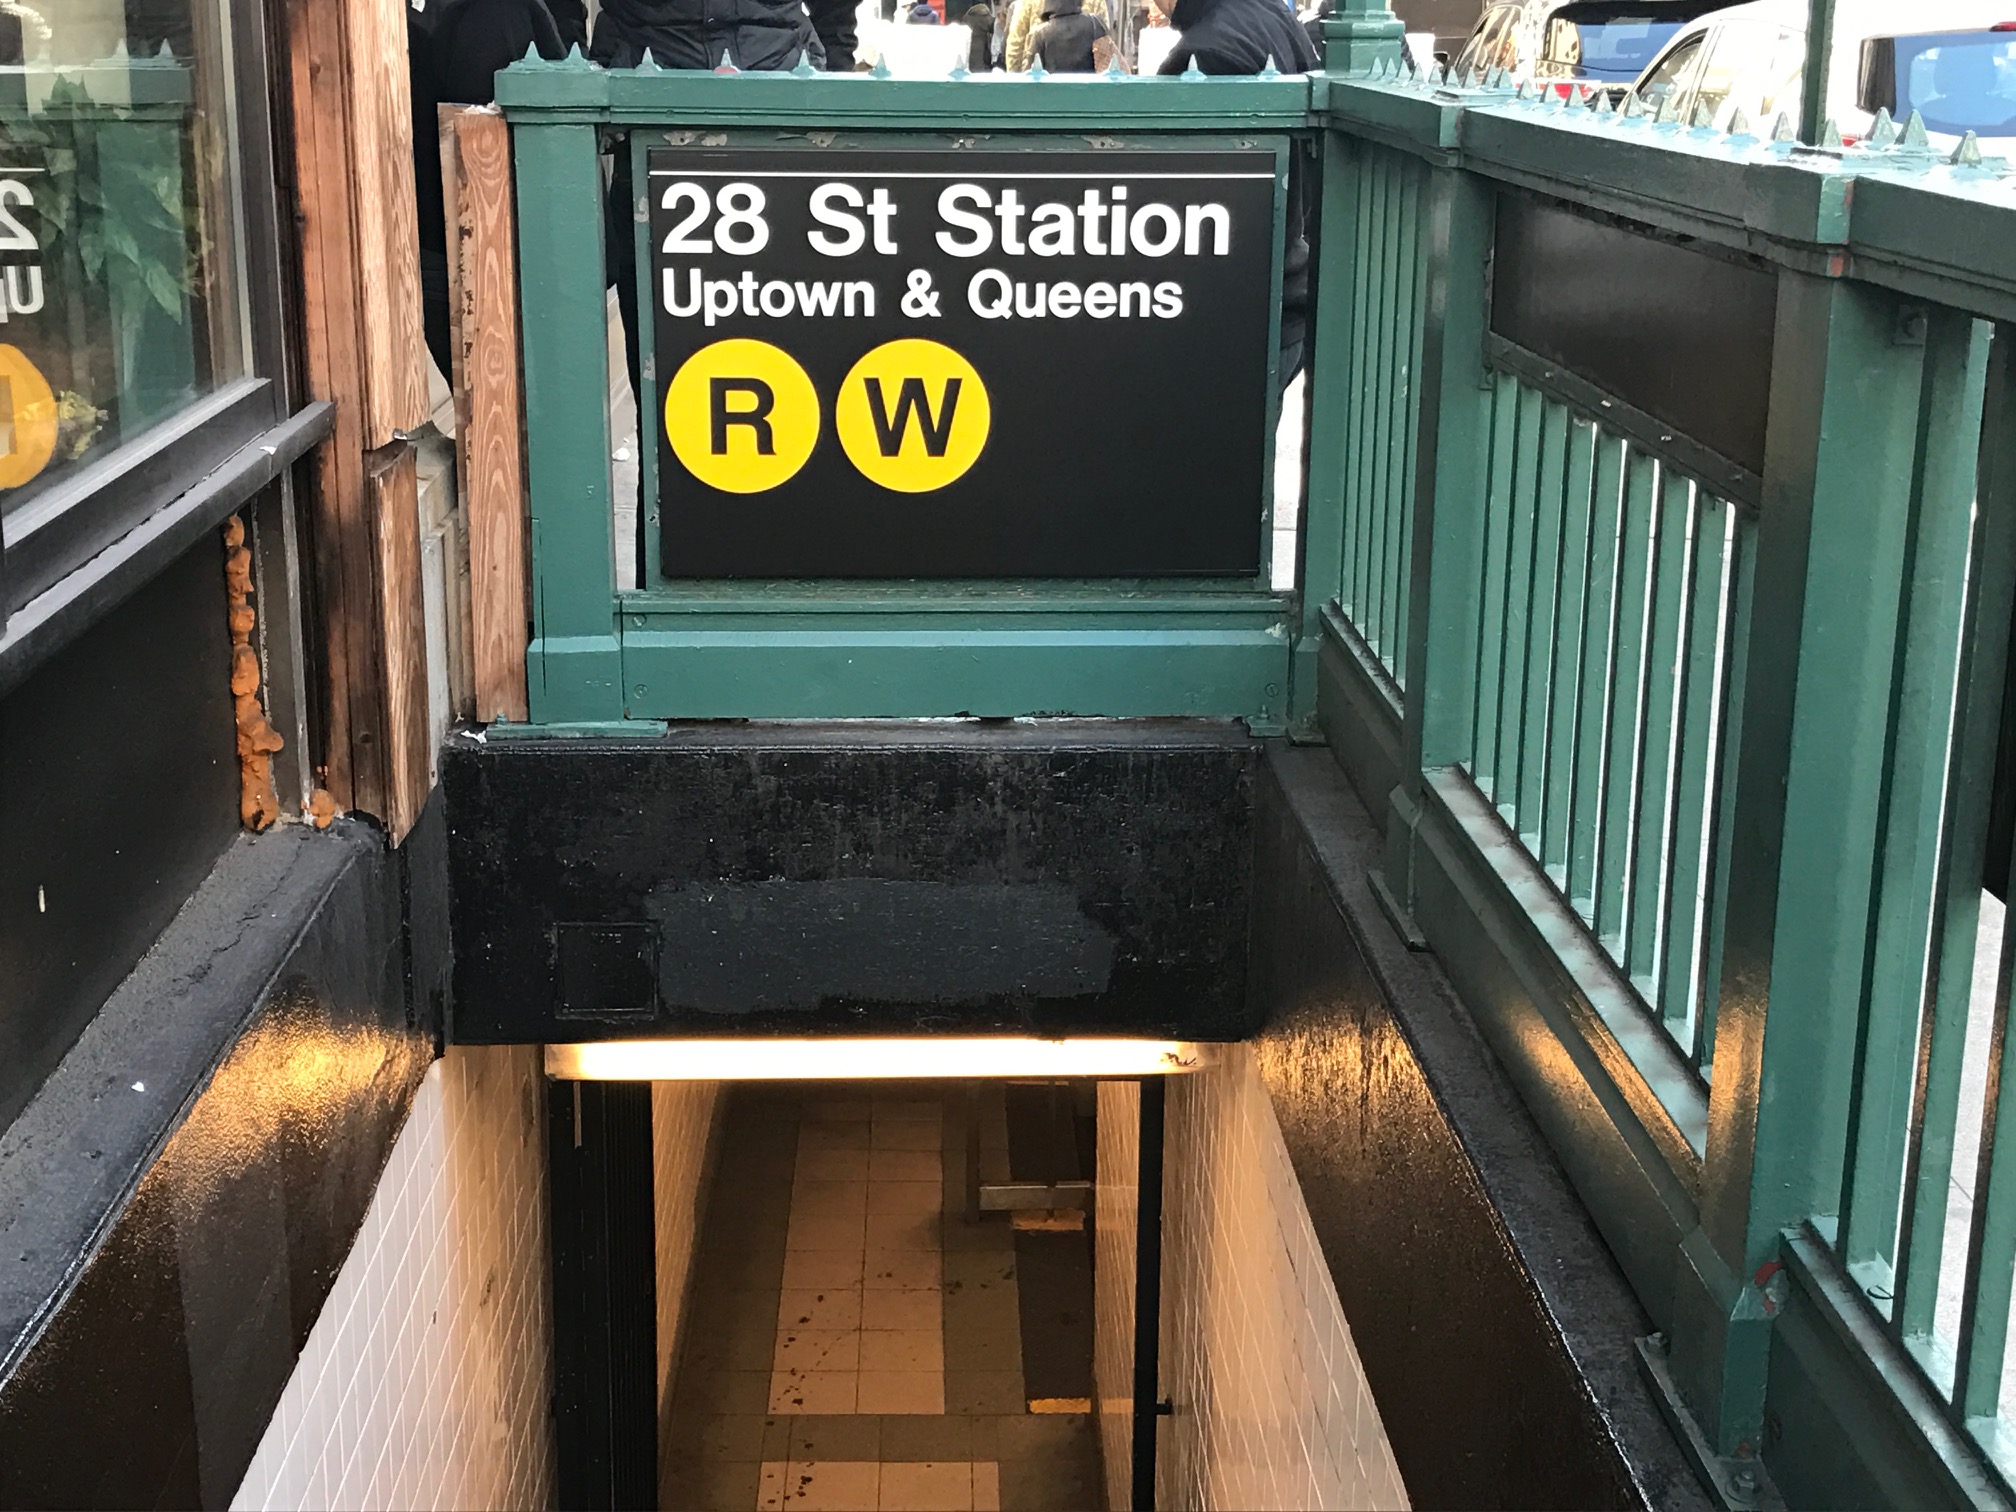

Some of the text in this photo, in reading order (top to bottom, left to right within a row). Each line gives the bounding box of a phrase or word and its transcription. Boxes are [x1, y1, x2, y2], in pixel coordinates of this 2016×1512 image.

[661, 181, 1231, 258] 28 St Station
[662, 267, 1184, 326] Uptown & Queens
[709, 377, 963, 458] R W
